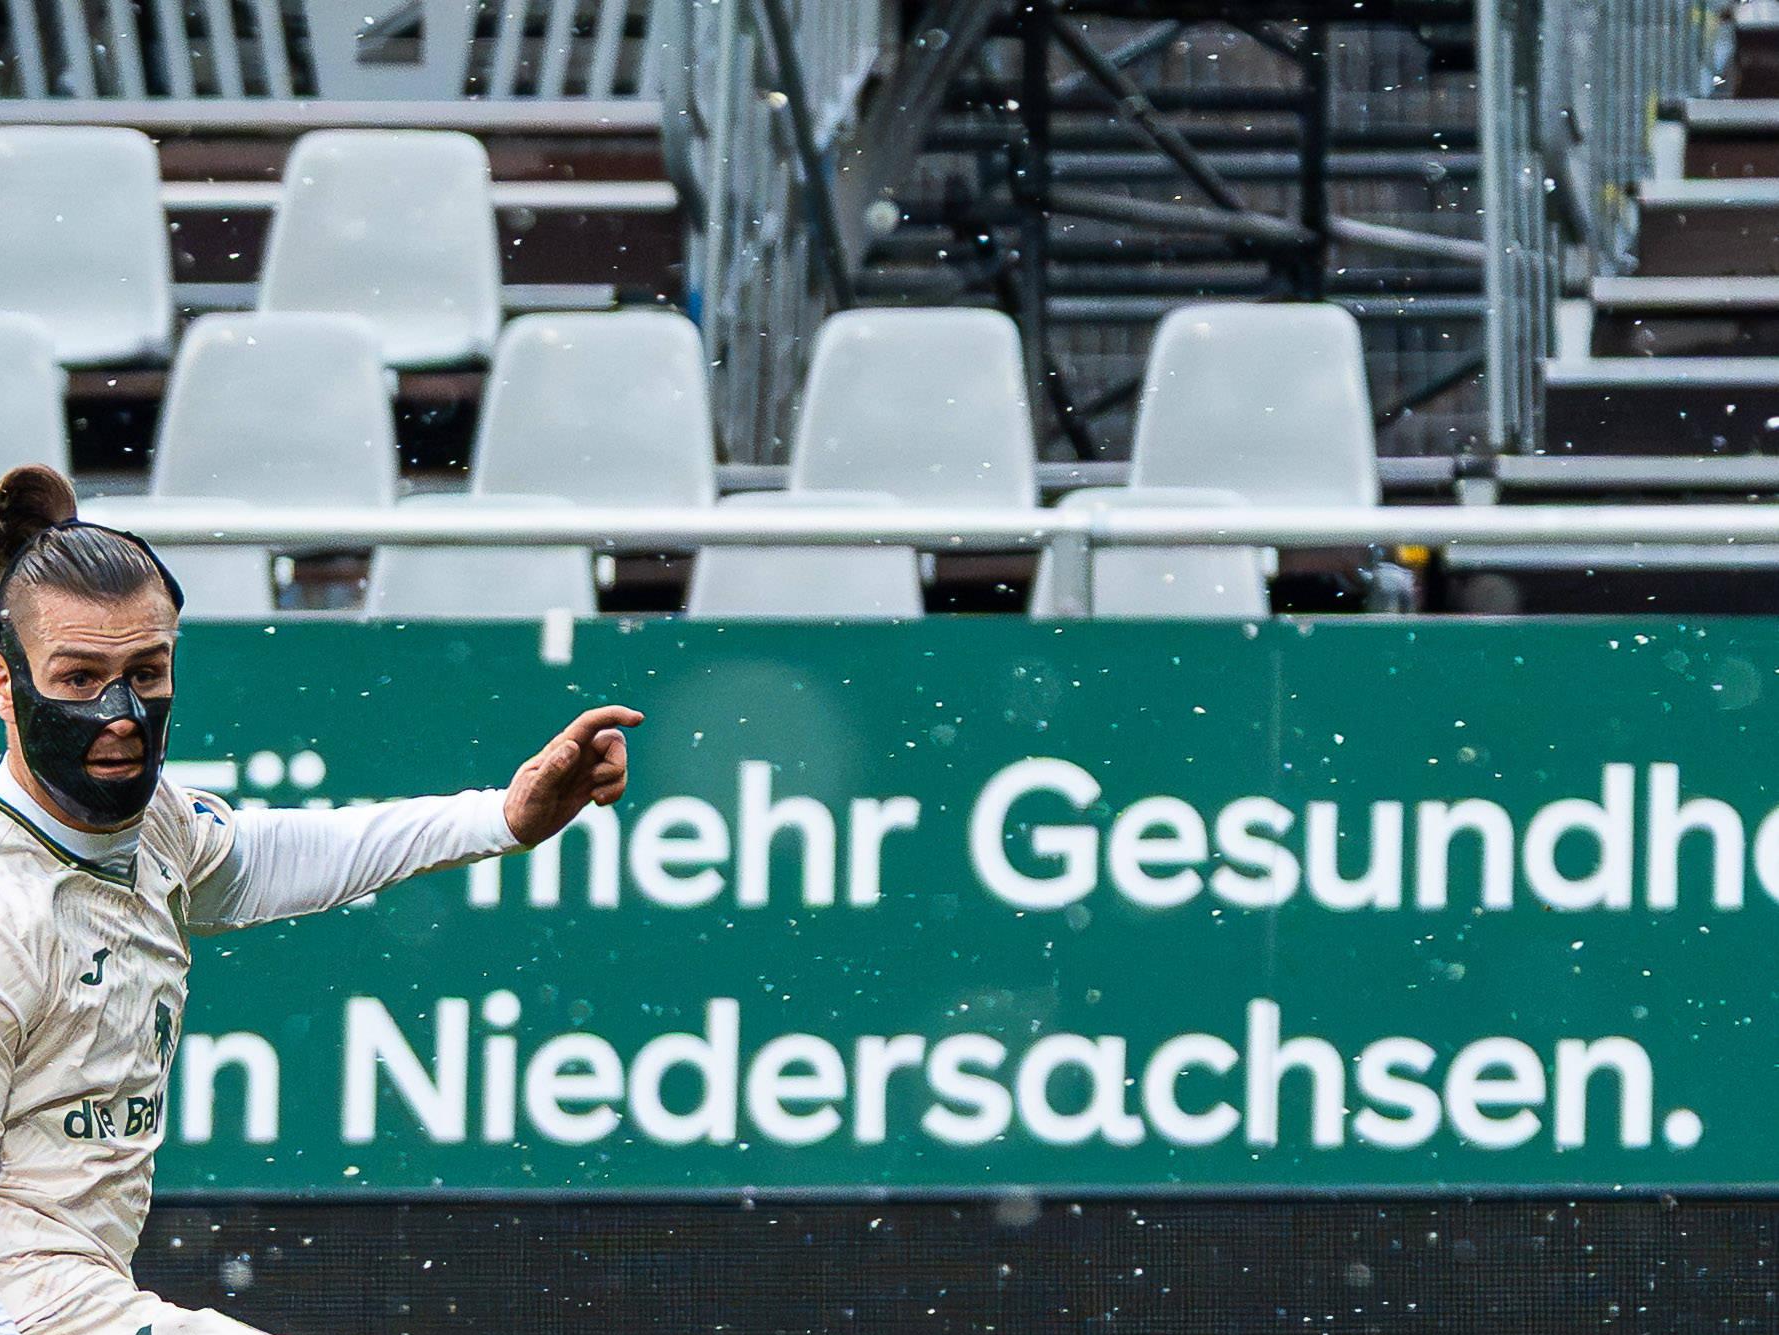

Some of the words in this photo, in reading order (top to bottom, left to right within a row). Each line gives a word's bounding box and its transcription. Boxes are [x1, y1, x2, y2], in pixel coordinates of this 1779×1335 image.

[968, 757, 1779, 911] Gesundh
[63, 1099, 116, 1139] die
[182, 1031, 280, 1143] n
[341, 989, 1704, 1149] Niedersachsen.
